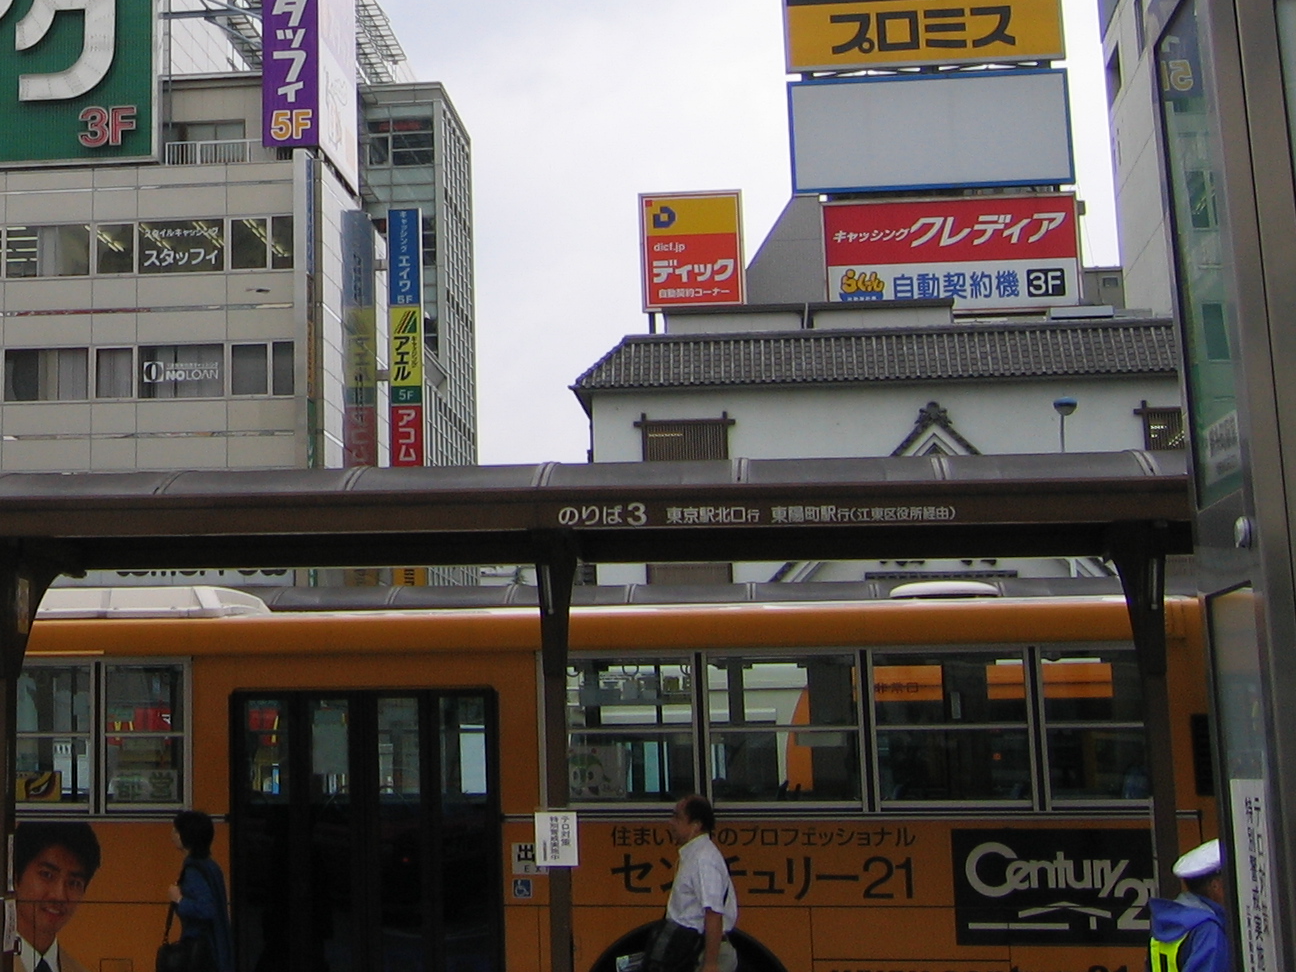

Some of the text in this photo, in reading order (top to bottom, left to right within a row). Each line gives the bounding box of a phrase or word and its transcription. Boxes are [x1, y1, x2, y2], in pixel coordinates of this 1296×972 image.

[829, 4, 1017, 56] プロミス
[78, 105, 137, 147] 3F
[270, 108, 313, 141] 5F
[833, 212, 1067, 248] キャッシング クレディア
[143, 247, 219, 267] スタッフィ
[398, 255, 412, 293] エイワ
[652, 258, 735, 284] ディック
[893, 269, 1063, 300] 自動契約機 3F
[393, 335, 411, 382] アエル
[398, 389, 414, 401] 5F
[398, 409, 416, 462] アコム
[557, 503, 649, 527] のりば3
[666, 506, 760, 523] 東京駅北口行
[517, 844, 536, 863] 出
[965, 841, 1130, 898] Century
